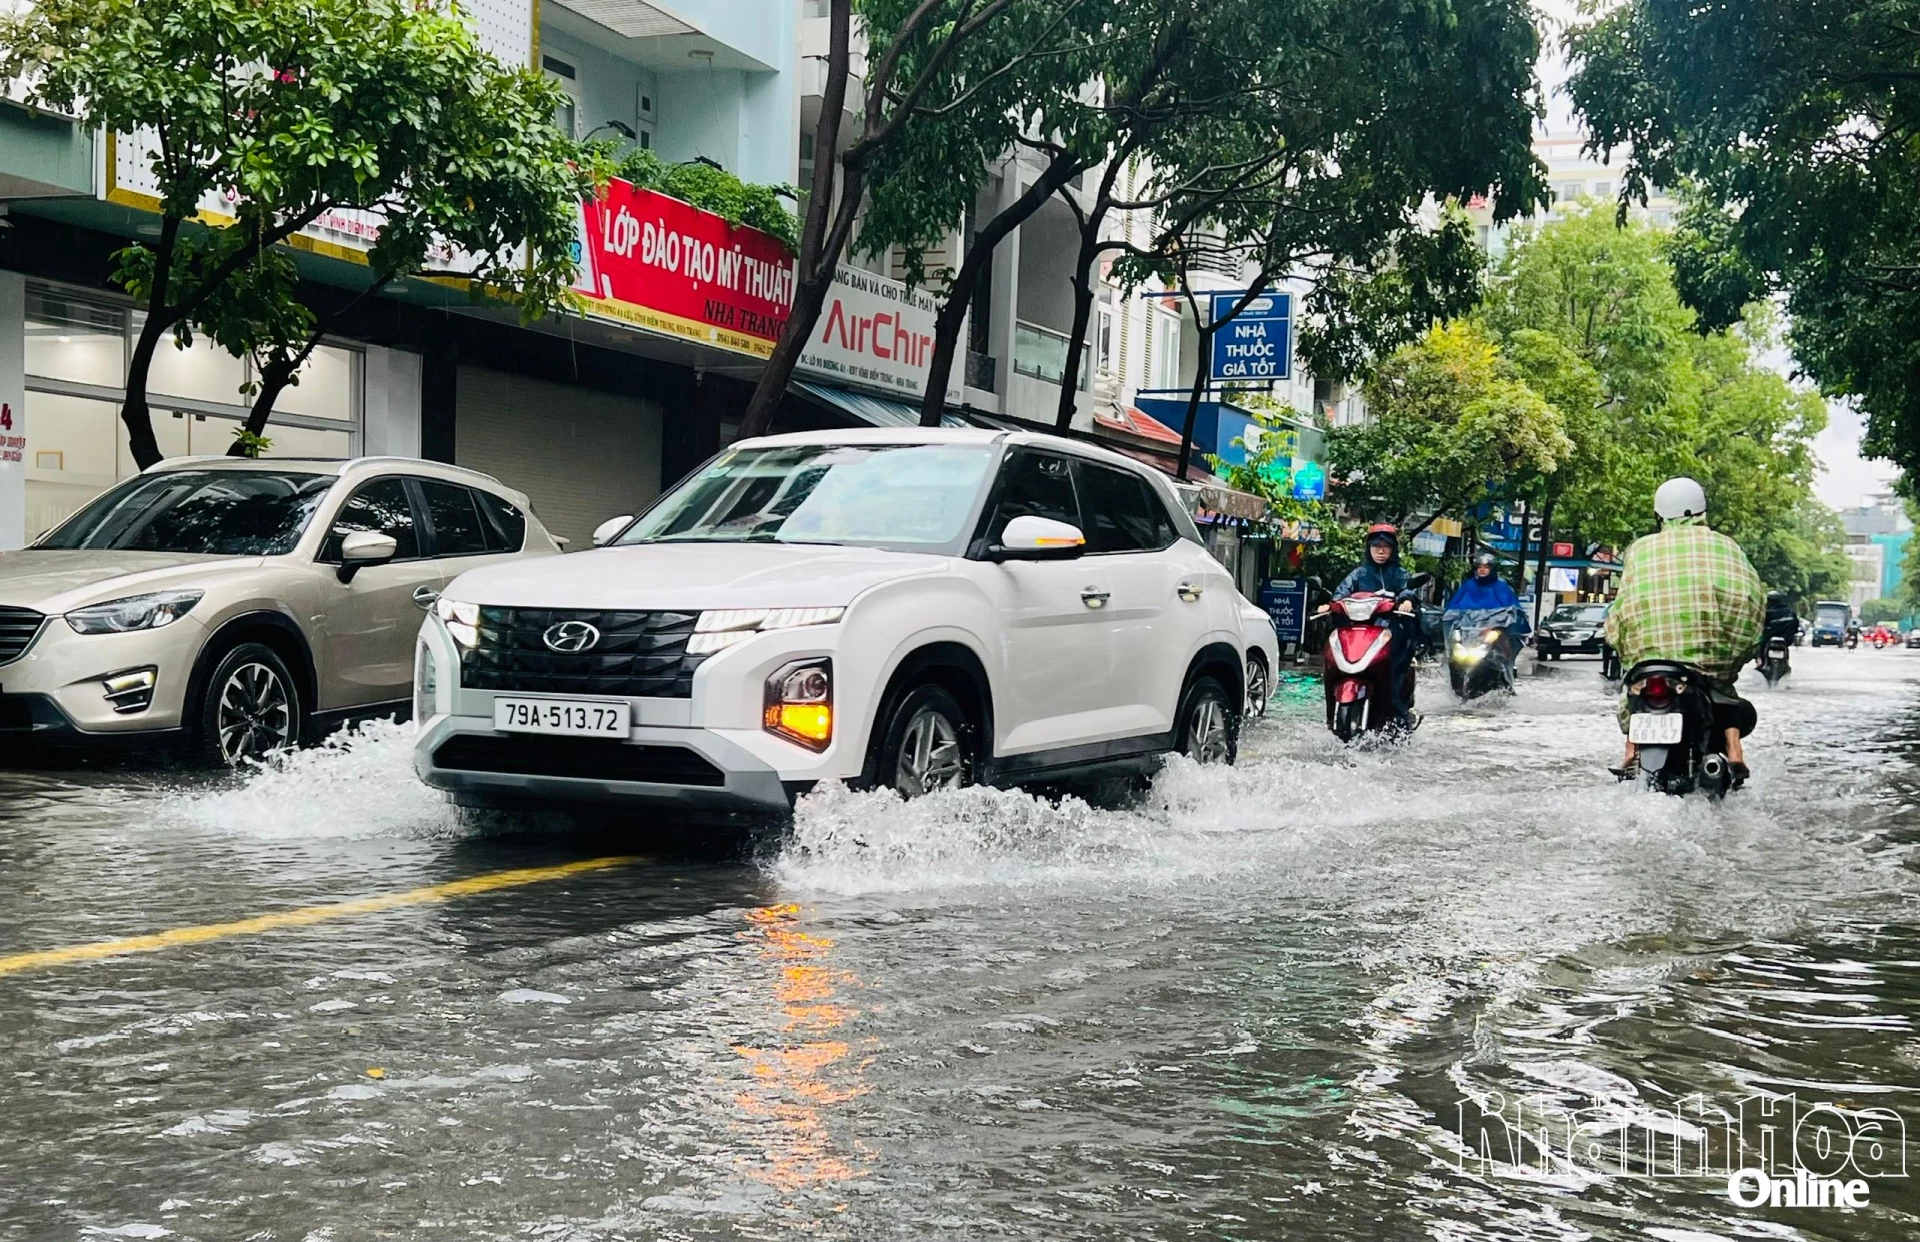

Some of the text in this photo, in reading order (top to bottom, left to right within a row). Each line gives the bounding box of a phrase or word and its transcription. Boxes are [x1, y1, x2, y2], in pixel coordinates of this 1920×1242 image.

[603, 204, 640, 259] LỚP
[641, 217, 680, 273] ĐÀO
[682, 234, 715, 291] TẠO
[716, 244, 743, 291] MỸ
[743, 259, 792, 314] THUẬT
[869, 279, 881, 296] VÀ
[881, 284, 898, 301] CHO
[702, 298, 734, 329] NHA
[822, 299, 937, 368] AirChir
[1235, 321, 1267, 338] NHÀ
[1225, 338, 1275, 357] THUỐC
[1222, 357, 1277, 376] GIÁ TỐT
[506, 704, 618, 731] 79A-513.72
